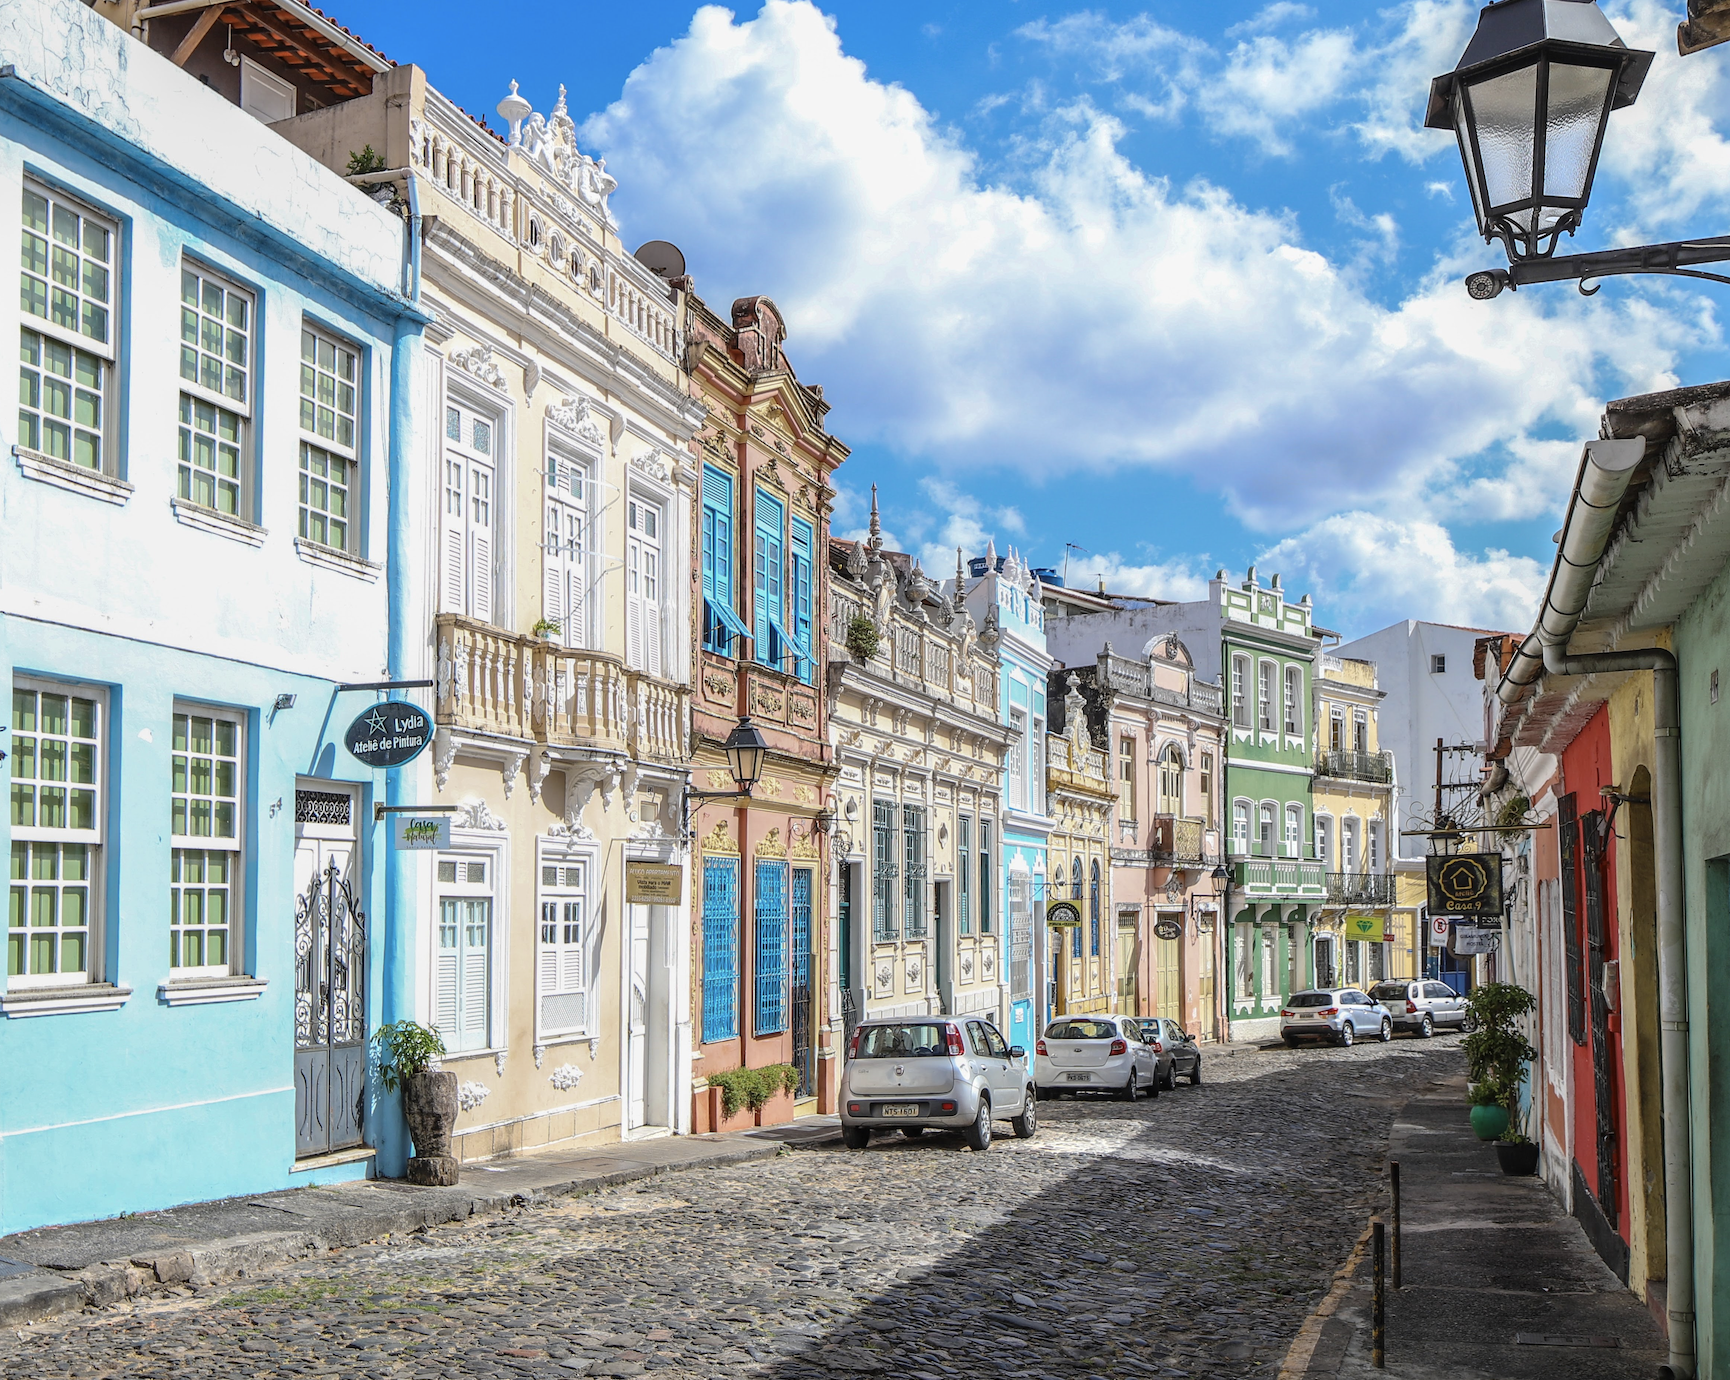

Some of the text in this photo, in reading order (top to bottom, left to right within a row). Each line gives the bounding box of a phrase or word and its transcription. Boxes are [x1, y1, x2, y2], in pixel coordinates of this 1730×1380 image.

[395, 714, 424, 733] Lydia
[353, 735, 423, 754] Ateliê de Pintura
[410, 818, 435, 834] Casa
[1446, 900, 1482, 911] Casa 9
